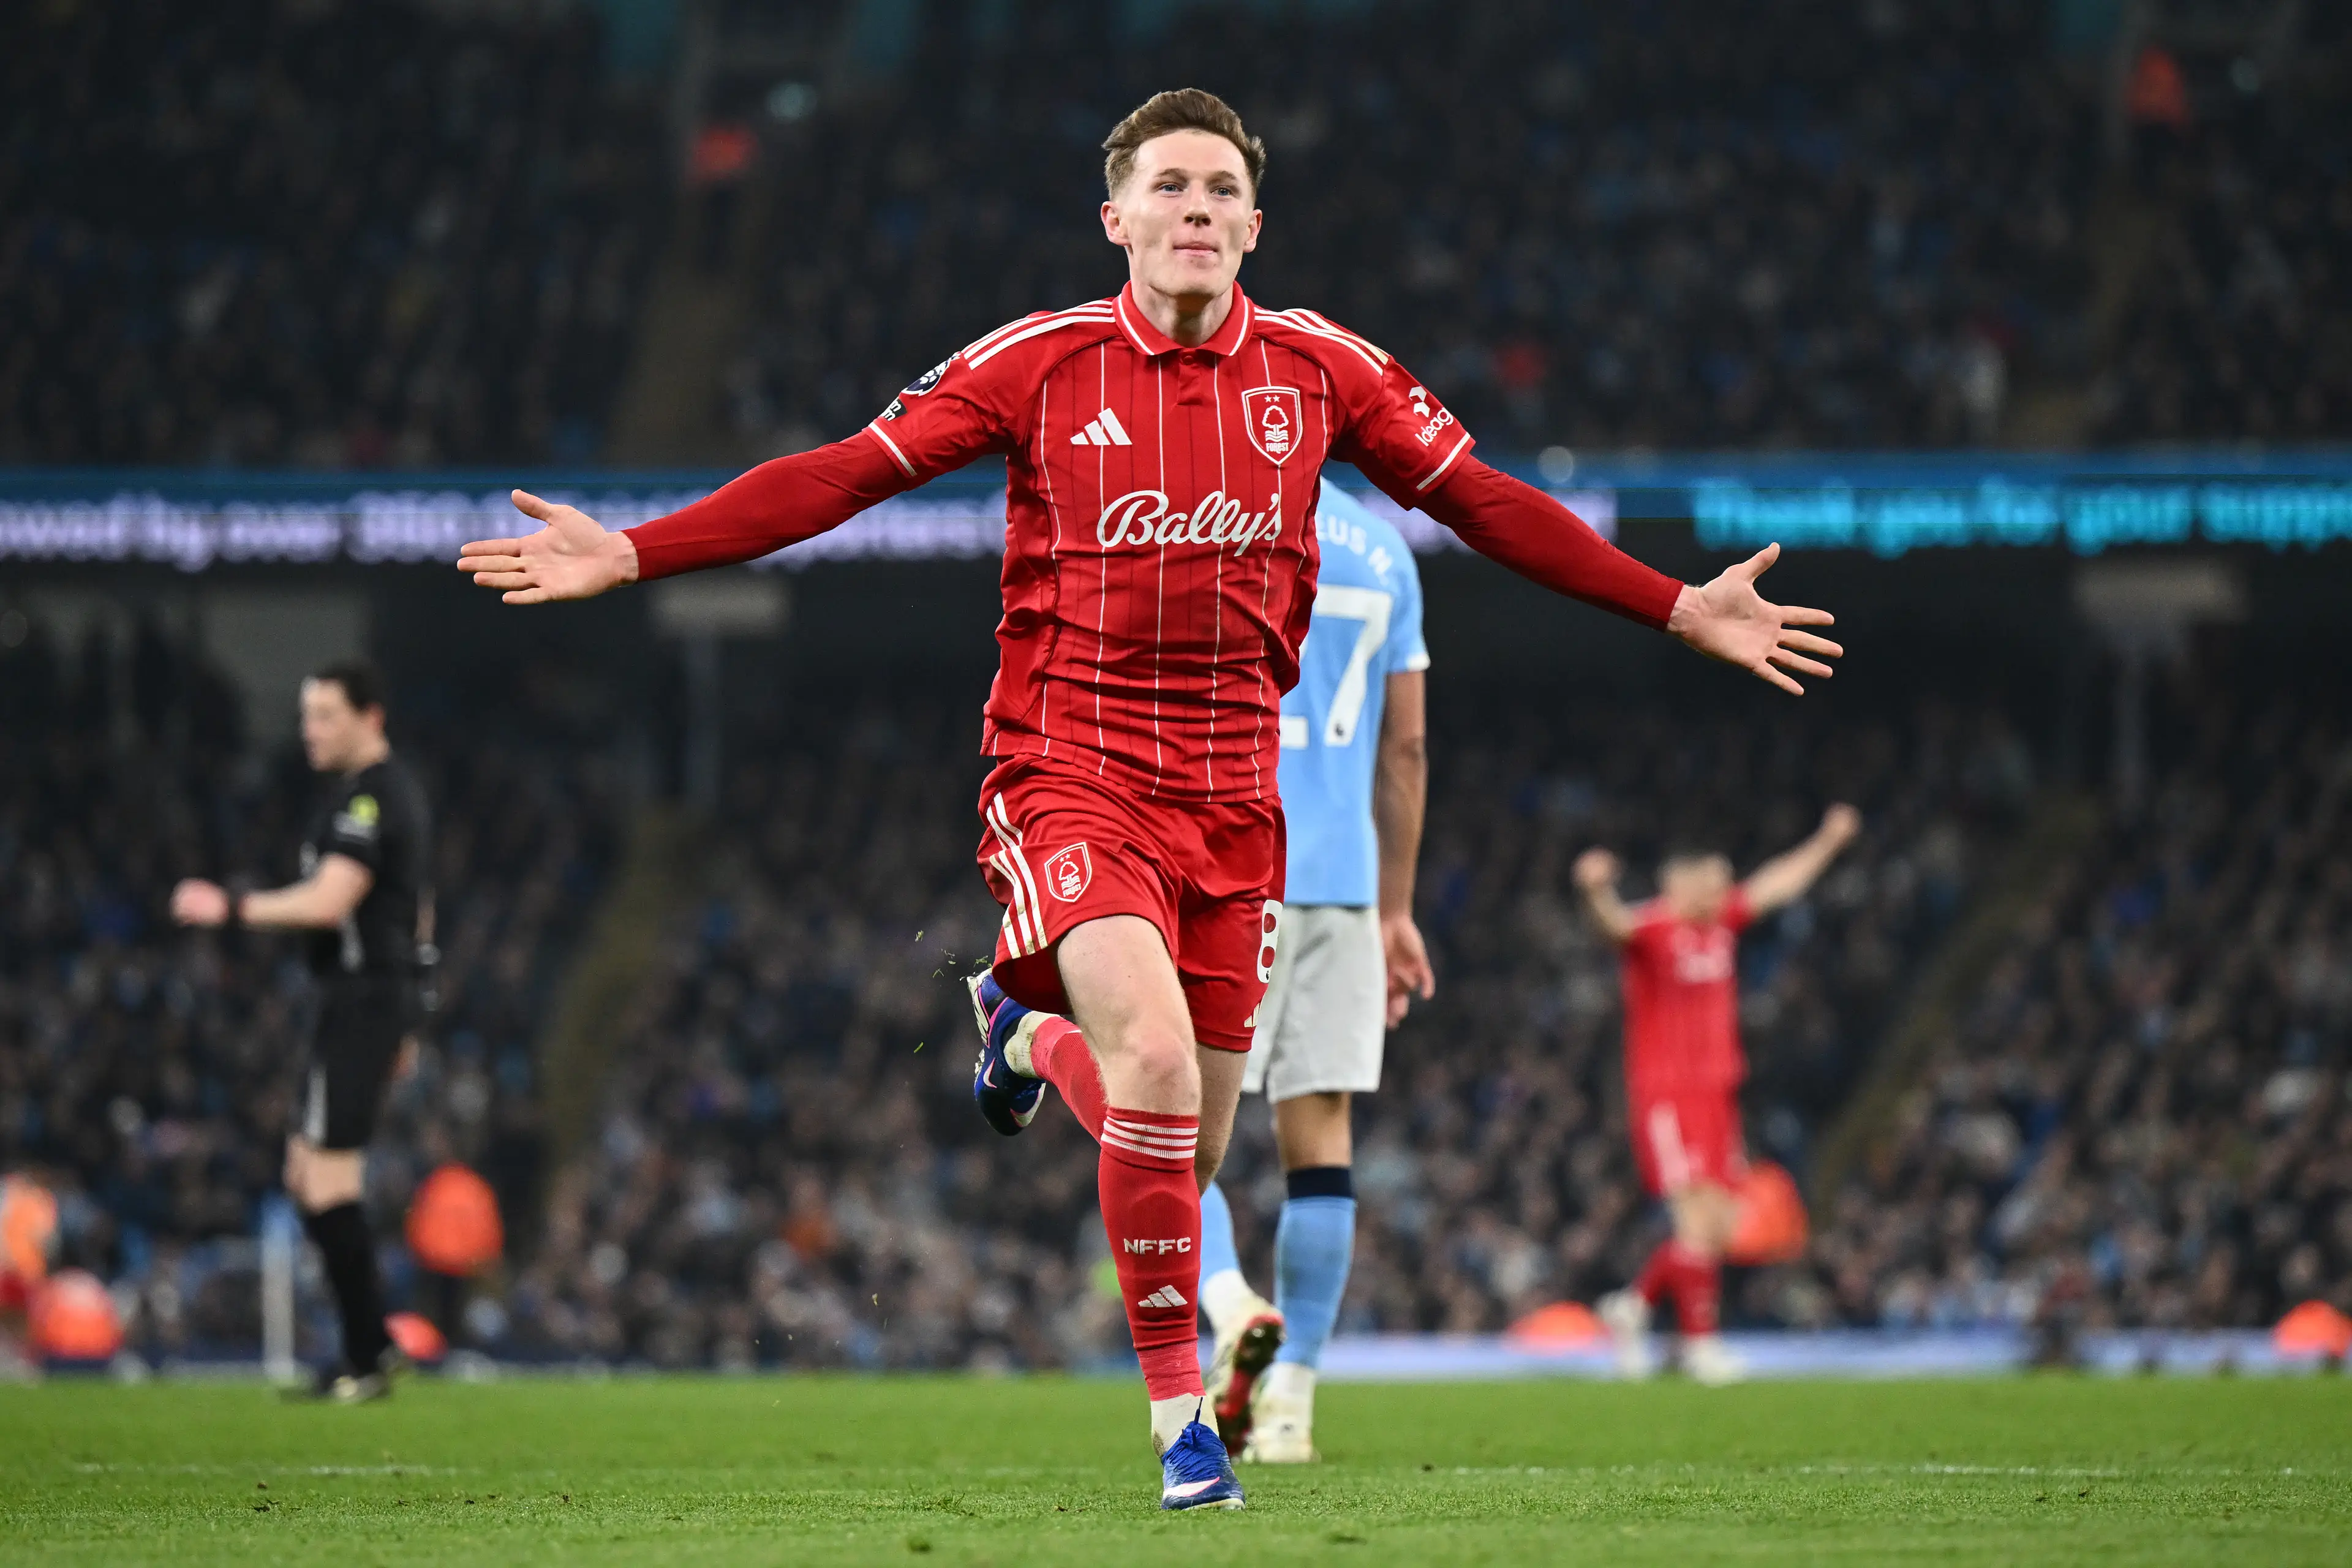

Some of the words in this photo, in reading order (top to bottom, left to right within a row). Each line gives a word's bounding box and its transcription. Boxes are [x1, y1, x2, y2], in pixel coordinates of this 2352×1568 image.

[1096, 490, 1282, 557] Bally's
[1280, 583, 1392, 750] 7
[1257, 899, 1283, 984] 8
[1123, 1237, 1191, 1256] NFFC
